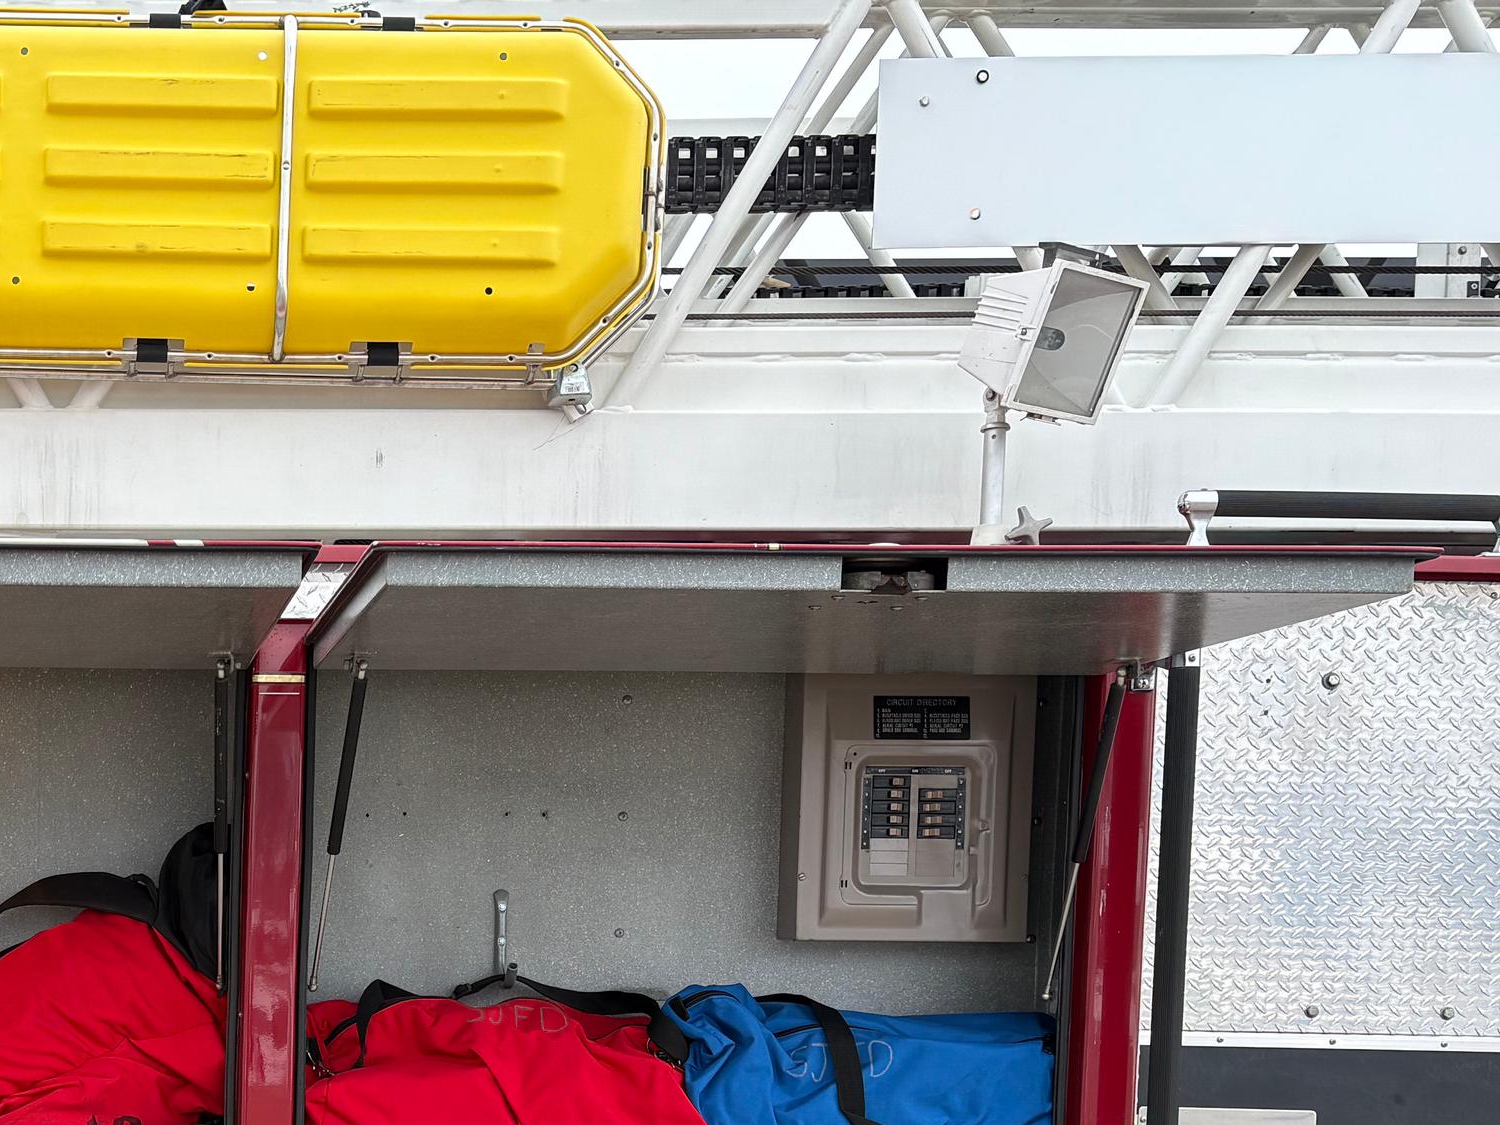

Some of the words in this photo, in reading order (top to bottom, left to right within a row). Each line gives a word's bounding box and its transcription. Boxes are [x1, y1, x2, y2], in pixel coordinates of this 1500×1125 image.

[886, 698, 913, 706] CIRCUIT
[916, 699, 957, 707] DIRECTORY
[785, 1040, 892, 1082] SJD
